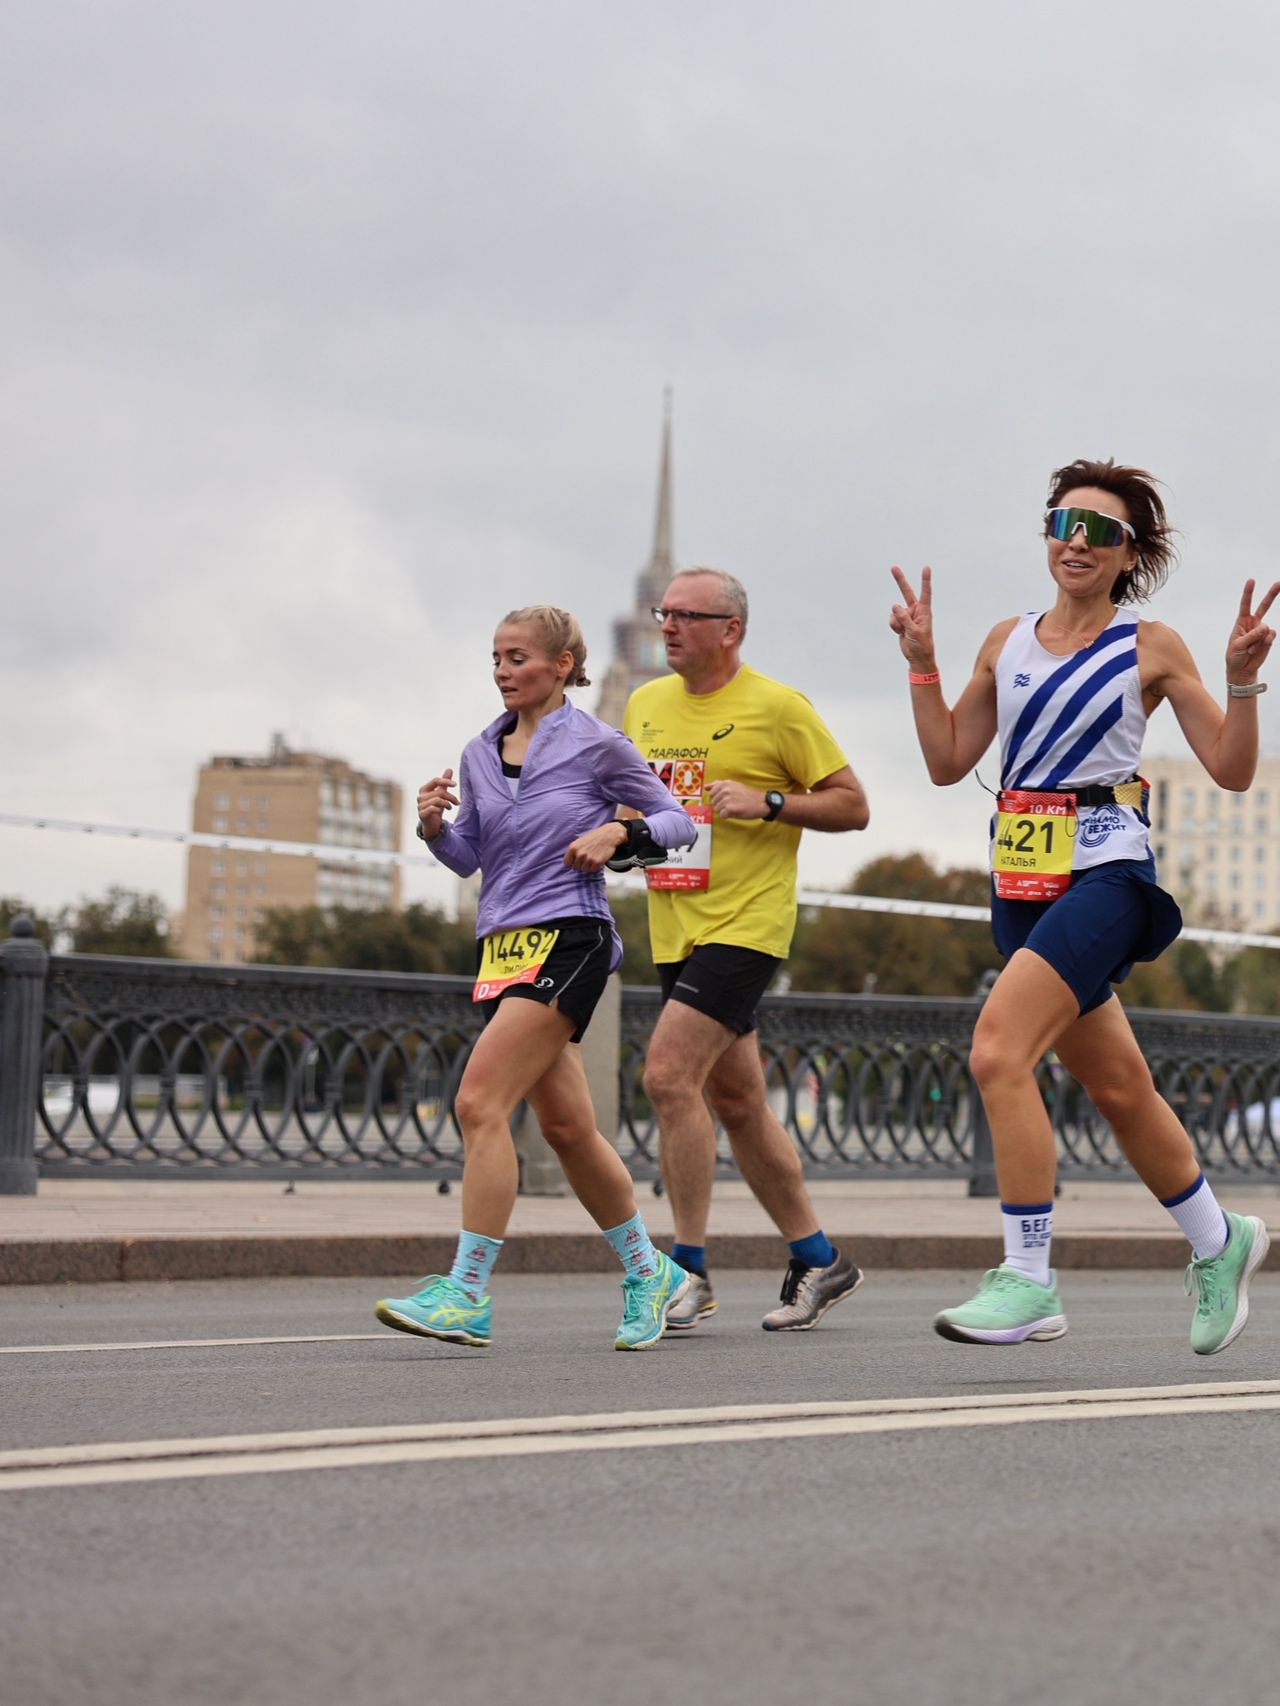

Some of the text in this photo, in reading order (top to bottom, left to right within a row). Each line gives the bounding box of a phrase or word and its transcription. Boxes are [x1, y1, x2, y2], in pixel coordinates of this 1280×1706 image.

[647, 747, 709, 759] МАРАФОН
[1029, 804, 1043, 814] 10
[1088, 824, 1126, 834] БЕЖИТ
[997, 819, 1054, 854] 421
[487, 929, 556, 965] 14492
[477, 983, 490, 999] D
